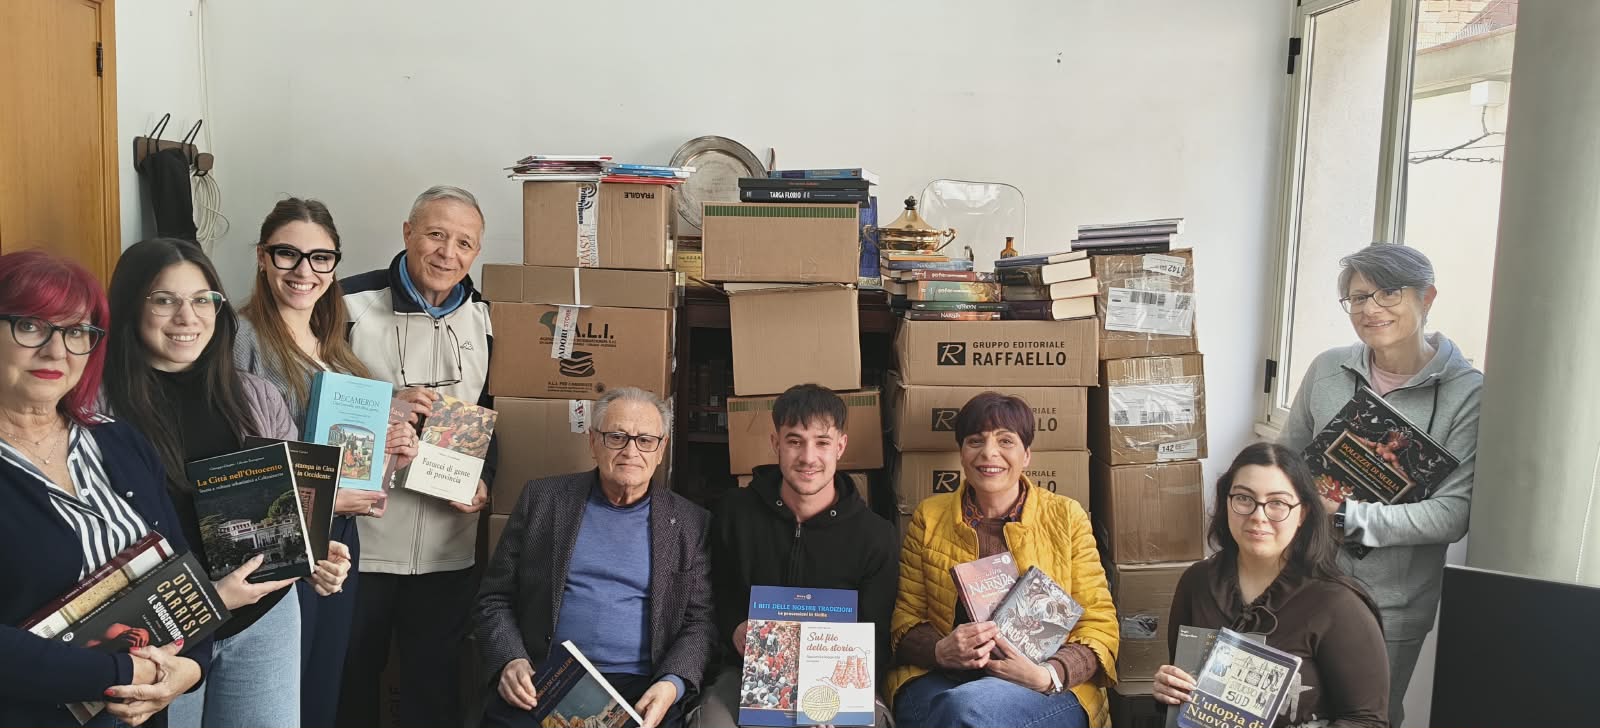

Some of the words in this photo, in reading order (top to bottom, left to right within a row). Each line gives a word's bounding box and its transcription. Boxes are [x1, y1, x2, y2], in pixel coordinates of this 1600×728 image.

[623, 191, 655, 199] FRAGILE
[769, 191, 785, 199] TARGA
[578, 202, 586, 224] ribuna
[972, 341, 1010, 349] GRUPPO
[1013, 341, 1065, 349] EDITORIALE
[972, 351, 1067, 366] RAFFAELLO
[333, 391, 381, 408] DECAMERON
[1033, 407, 1057, 415] RIALE
[1161, 444, 1175, 453] 142
[294, 463, 316, 472] stampa
[322, 465, 335, 473] Cina
[446, 464, 454, 473] di
[454, 468, 471, 478] gente
[1341, 442, 1372, 470] DOLCEZZE
[1378, 472, 1400, 491] SICILIA
[196, 479, 208, 488] La
[208, 474, 229, 485] Città
[229, 464, 283, 481] nell'Ottocento
[303, 470, 332, 480] Occidente
[426, 468, 433, 476] di
[433, 471, 462, 484] provincia
[968, 573, 1017, 595] NARNIA
[172, 573, 212, 625] DONATO
[157, 580, 201, 638] CARRISI
[792, 604, 817, 612] NOSTRE
[818, 605, 853, 613] TRADIZIONI
[147, 594, 157, 606] IL
[152, 601, 184, 642] SUGGERITORE
[806, 632, 824, 642] Sul
[824, 633, 839, 643] filo
[1000, 620, 1024, 643] Harry
[1017, 633, 1043, 662] Potter
[806, 643, 829, 652] della
[829, 643, 856, 652] storia
[1225, 690, 1250, 707] SUD
[1186, 704, 1230, 728] Nuovo
[1192, 693, 1246, 726] L'utopia
[1248, 720, 1265, 728] di
